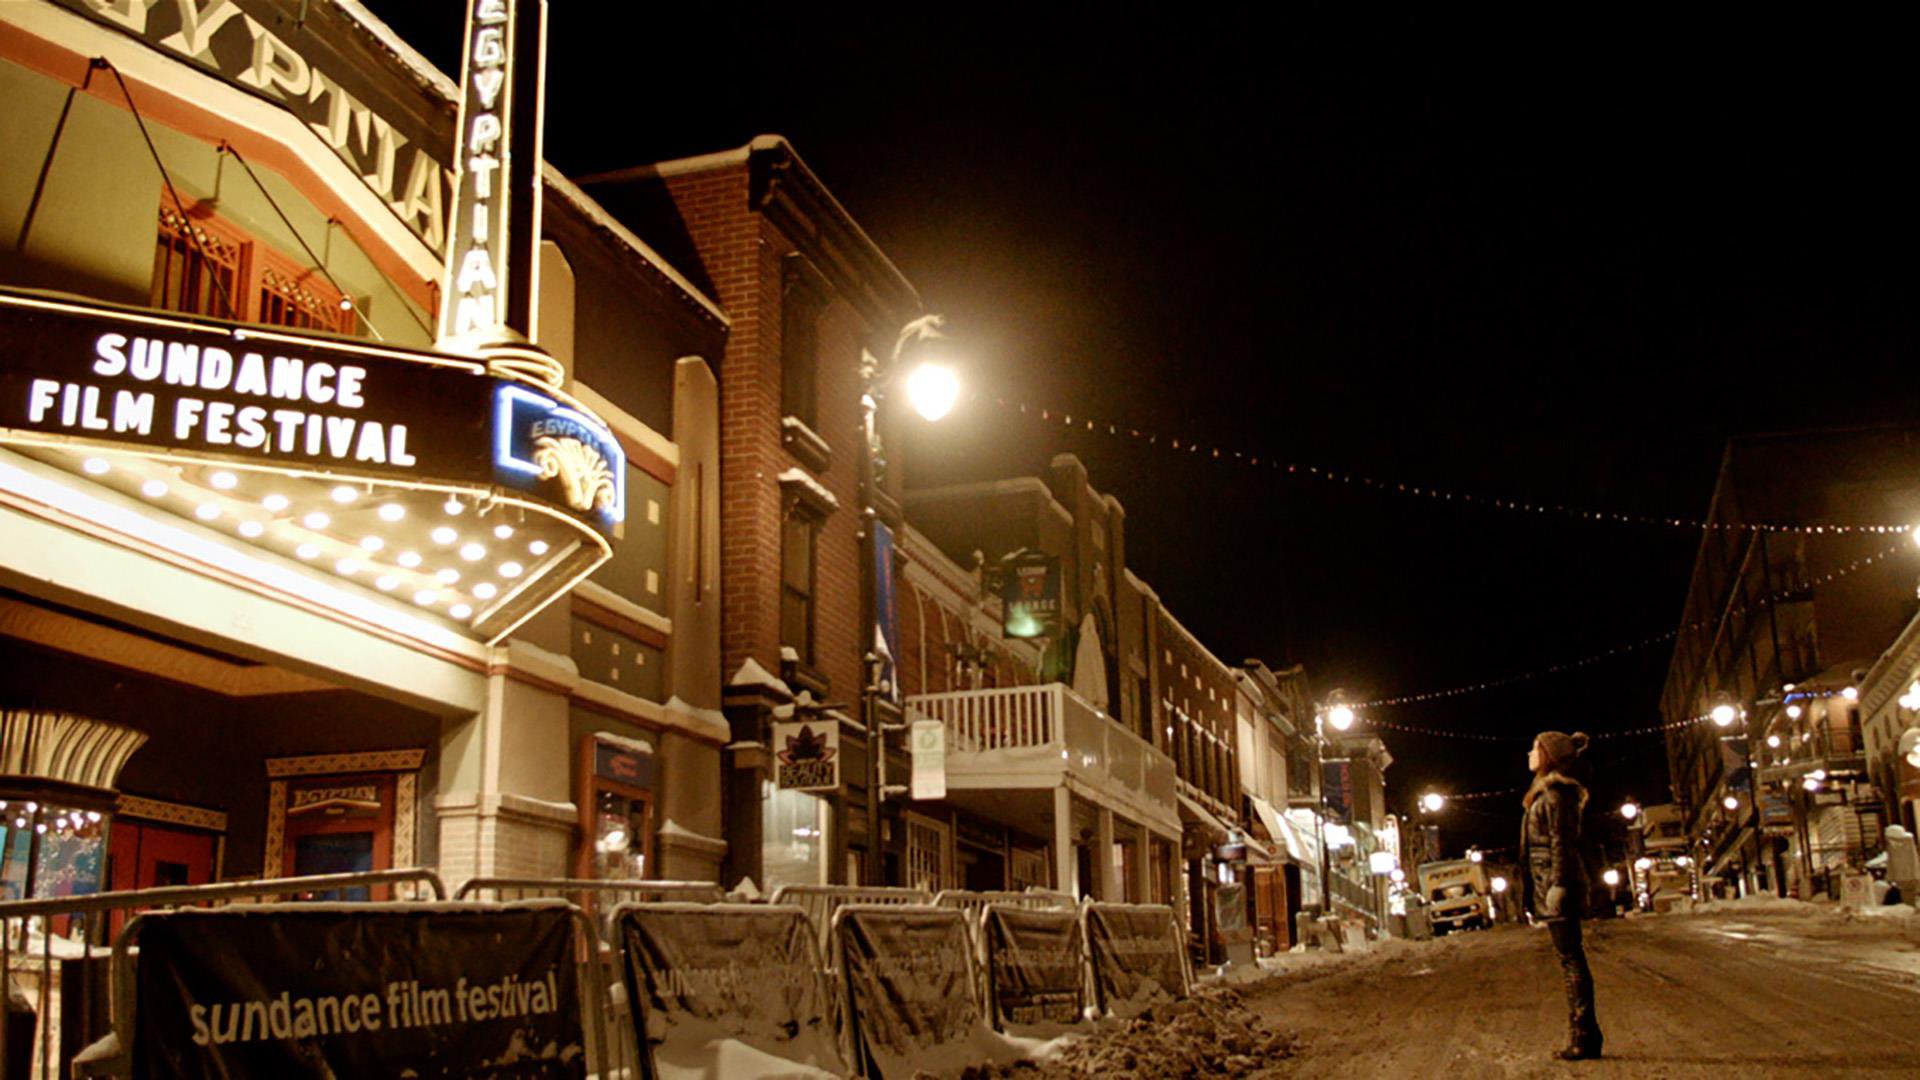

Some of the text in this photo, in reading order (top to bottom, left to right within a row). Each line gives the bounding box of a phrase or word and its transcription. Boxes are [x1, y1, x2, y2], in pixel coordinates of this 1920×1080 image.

[93, 333, 367, 409] SUNDANCE
[28, 378, 417, 467] FILM FESTIVAL
[190, 970, 558, 1045] sundance film festival
